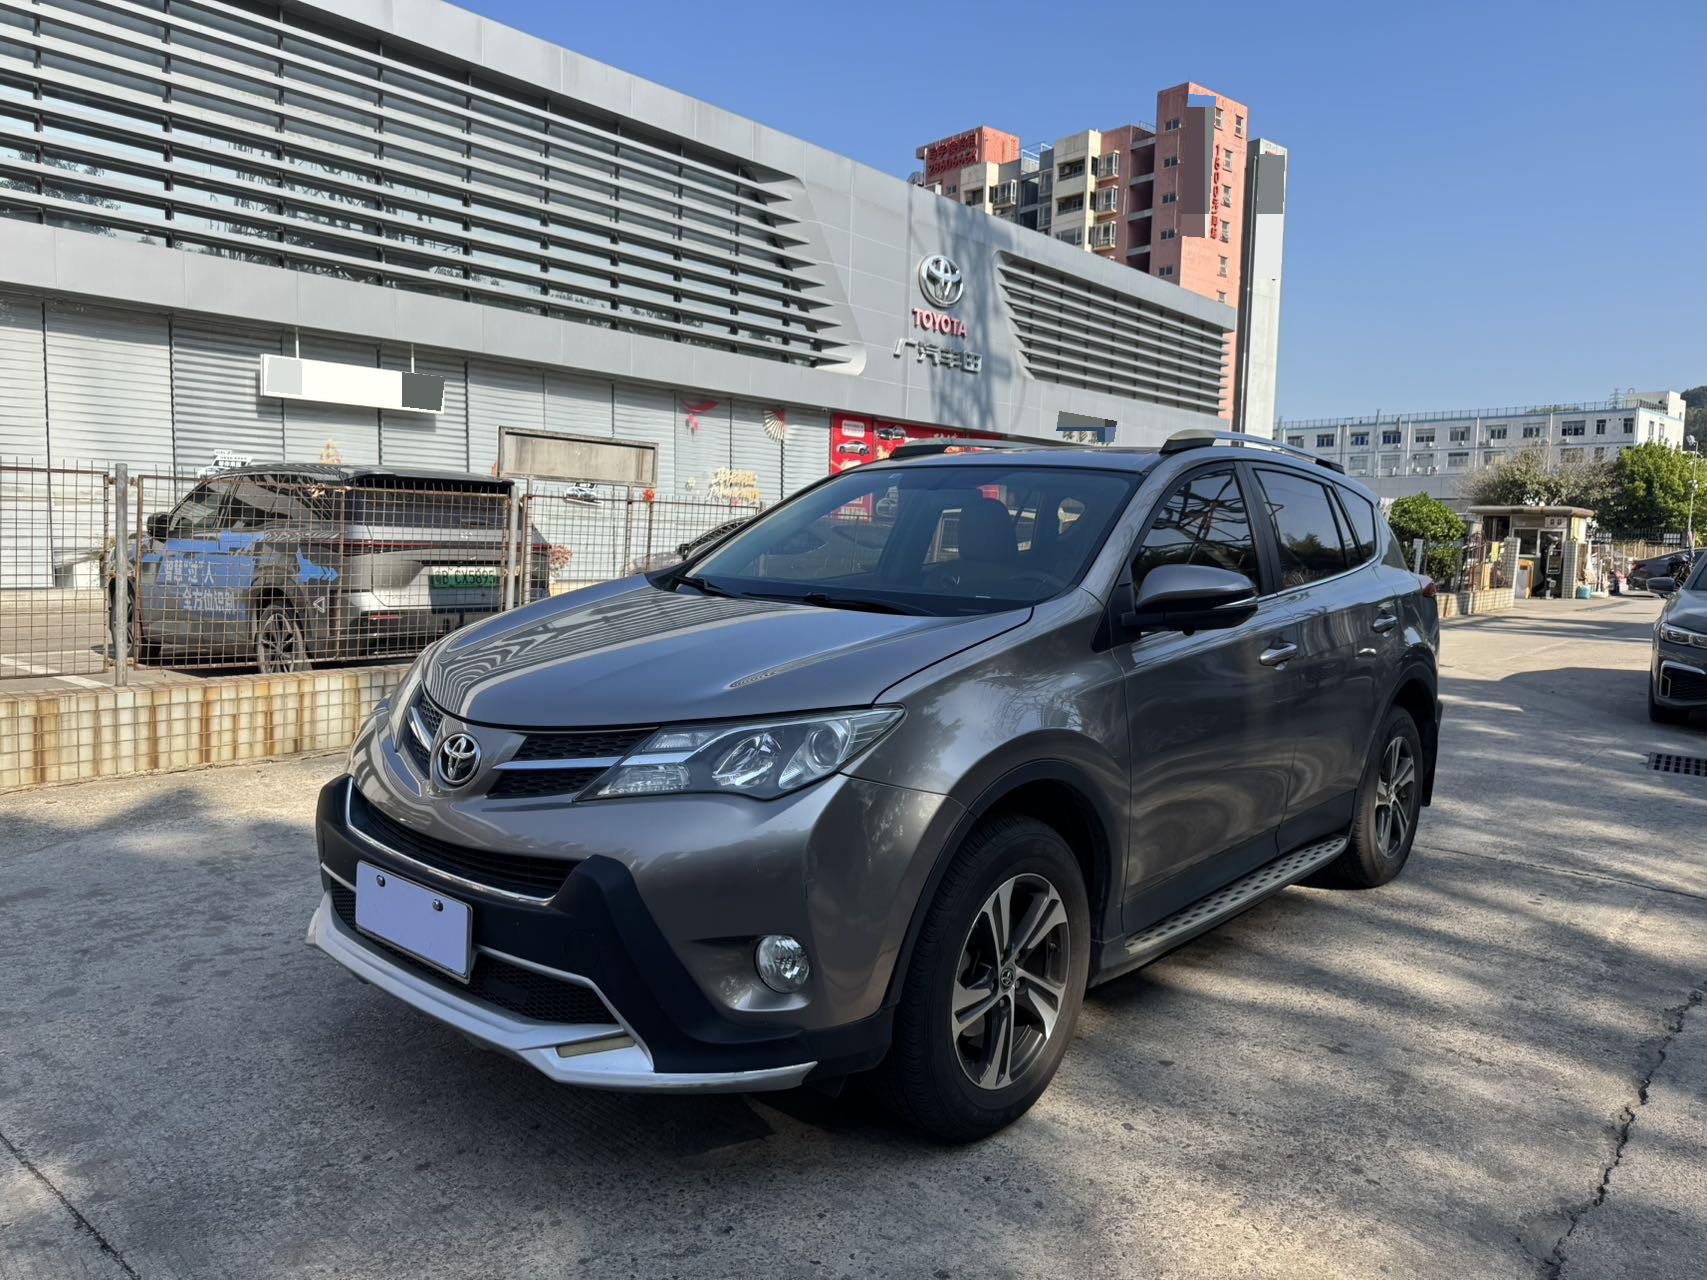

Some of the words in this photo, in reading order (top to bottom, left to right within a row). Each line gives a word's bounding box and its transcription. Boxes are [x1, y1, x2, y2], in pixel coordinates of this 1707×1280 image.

[912, 308, 967, 338] TOYOTA
[893, 338, 982, 374] 广汽丰田
